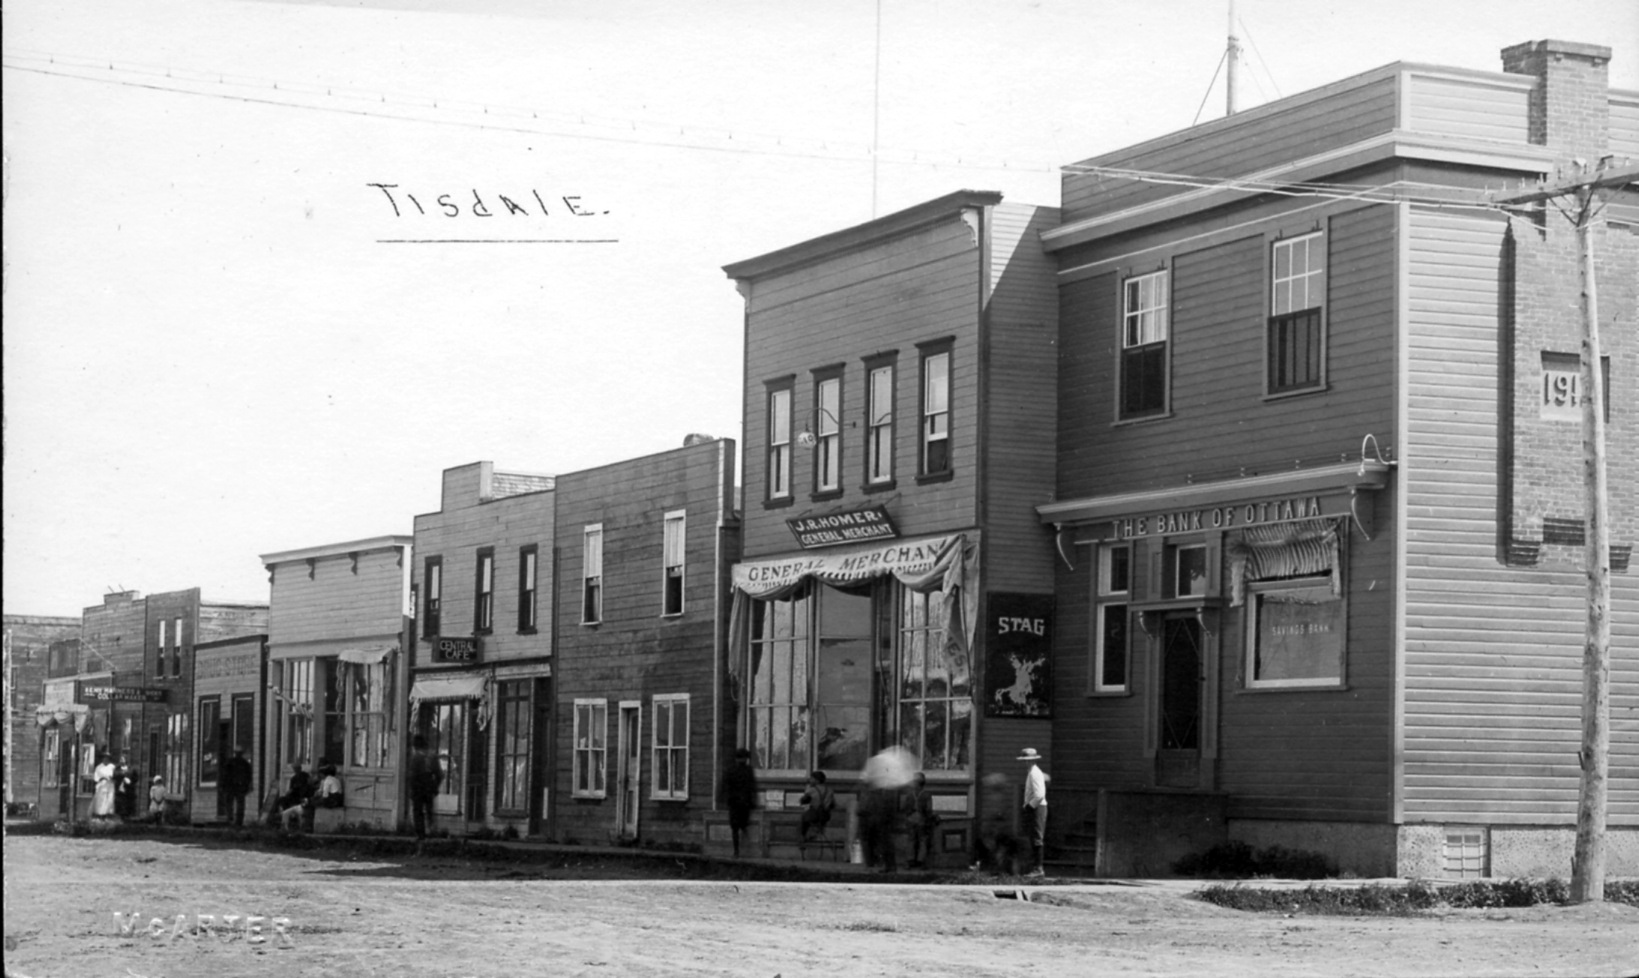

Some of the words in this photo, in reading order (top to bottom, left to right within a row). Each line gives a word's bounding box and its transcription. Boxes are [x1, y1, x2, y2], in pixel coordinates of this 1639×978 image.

[1111, 517, 1147, 539] THE
[1157, 511, 1202, 533] BANK
[1212, 507, 1235, 527] OF
[1245, 496, 1320, 523] OTTAWA
[801, 530, 843, 545] GENERAL
[841, 523, 893, 540] MERCHANT
[748, 559, 826, 582] GENERAL
[998, 616, 1045, 636] STAG
[440, 640, 477, 653] CENTRAL
[445, 650, 471, 660] CAFE
